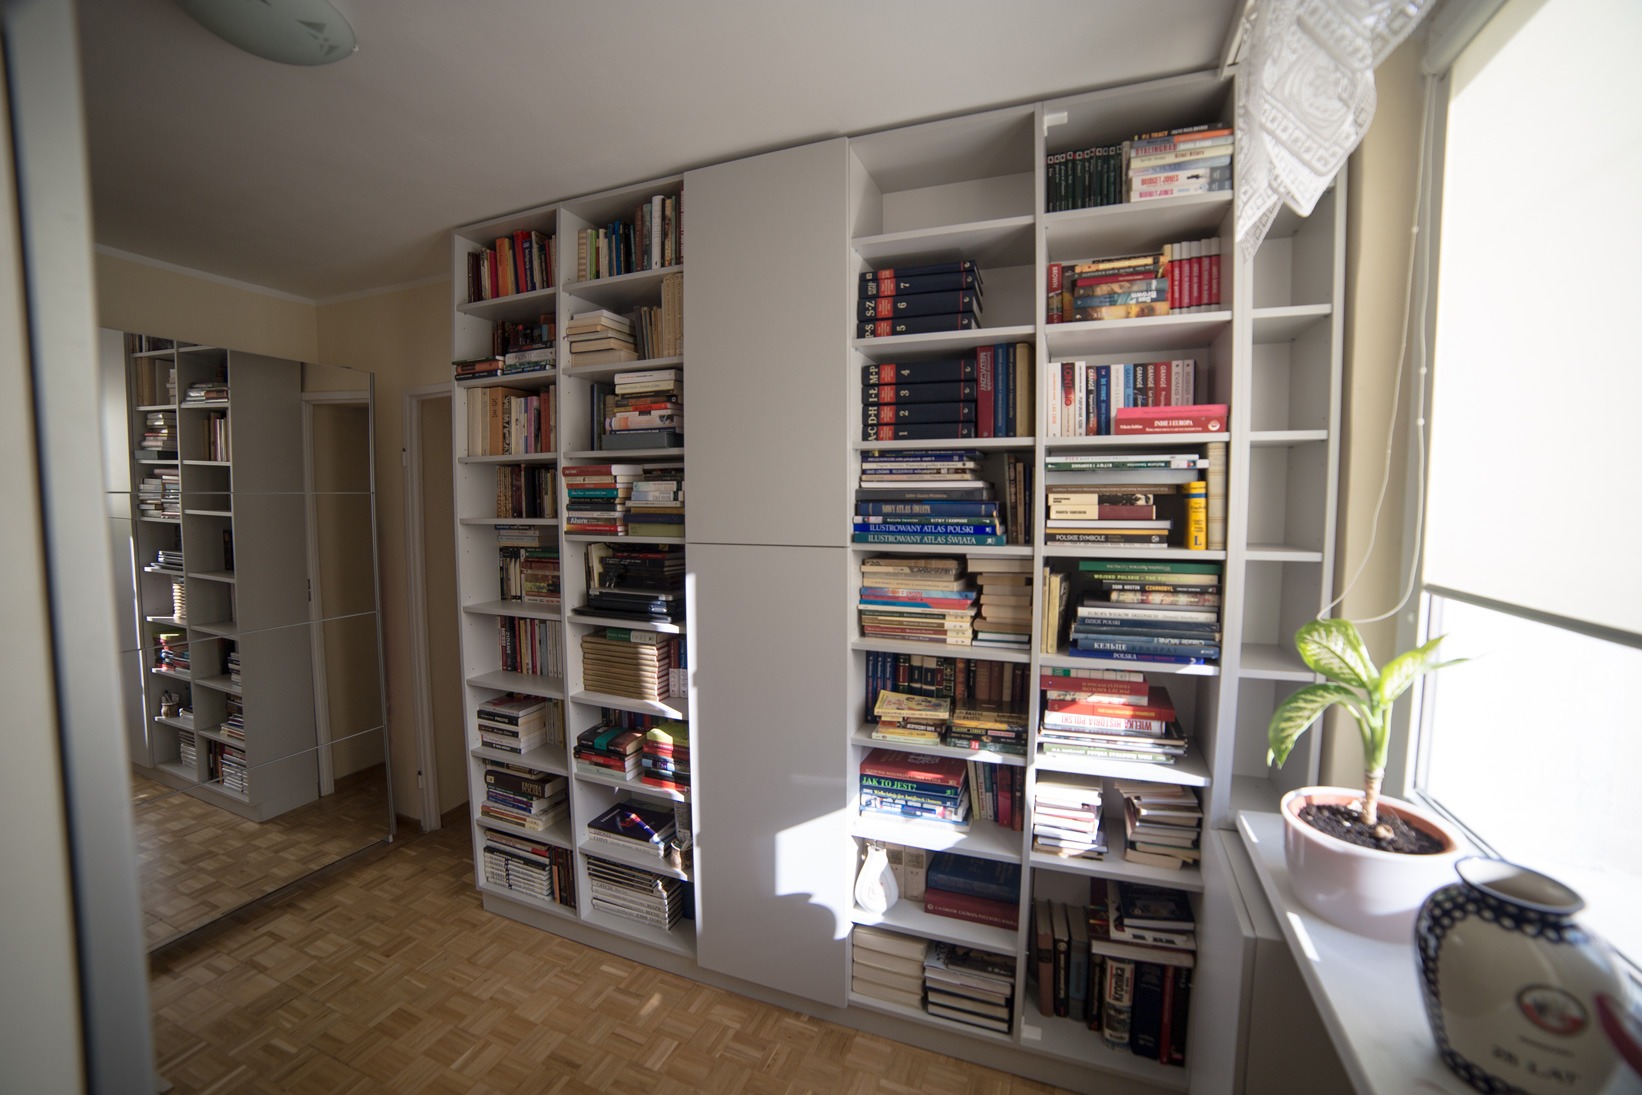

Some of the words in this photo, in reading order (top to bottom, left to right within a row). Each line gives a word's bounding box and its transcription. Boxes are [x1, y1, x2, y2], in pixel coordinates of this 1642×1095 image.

[1135, 143, 1177, 156] STALINGRAD
[1064, 365, 1072, 406] LONTANO
[870, 524, 922, 533] ILUSTROWANY
[923, 524, 946, 533] ATLAS
[947, 525, 974, 533] POLSKI
[868, 534, 922, 543] ILUSTROWANY
[923, 535, 946, 543] ATLAS
[947, 534, 976, 544] ŚWIATA
[1094, 642, 1127, 651] КЕЛЬЦЕ
[1062, 715, 1086, 726] POLSKI
[1089, 718, 1122, 729] HISTORIA
[1124, 719, 1152, 731] WIELKA
[862, 777, 879, 786] JAK
[894, 781, 916, 791] JEST?
[522, 787, 542, 797] POLSKI
[1112, 967, 1125, 1002] Kronika
